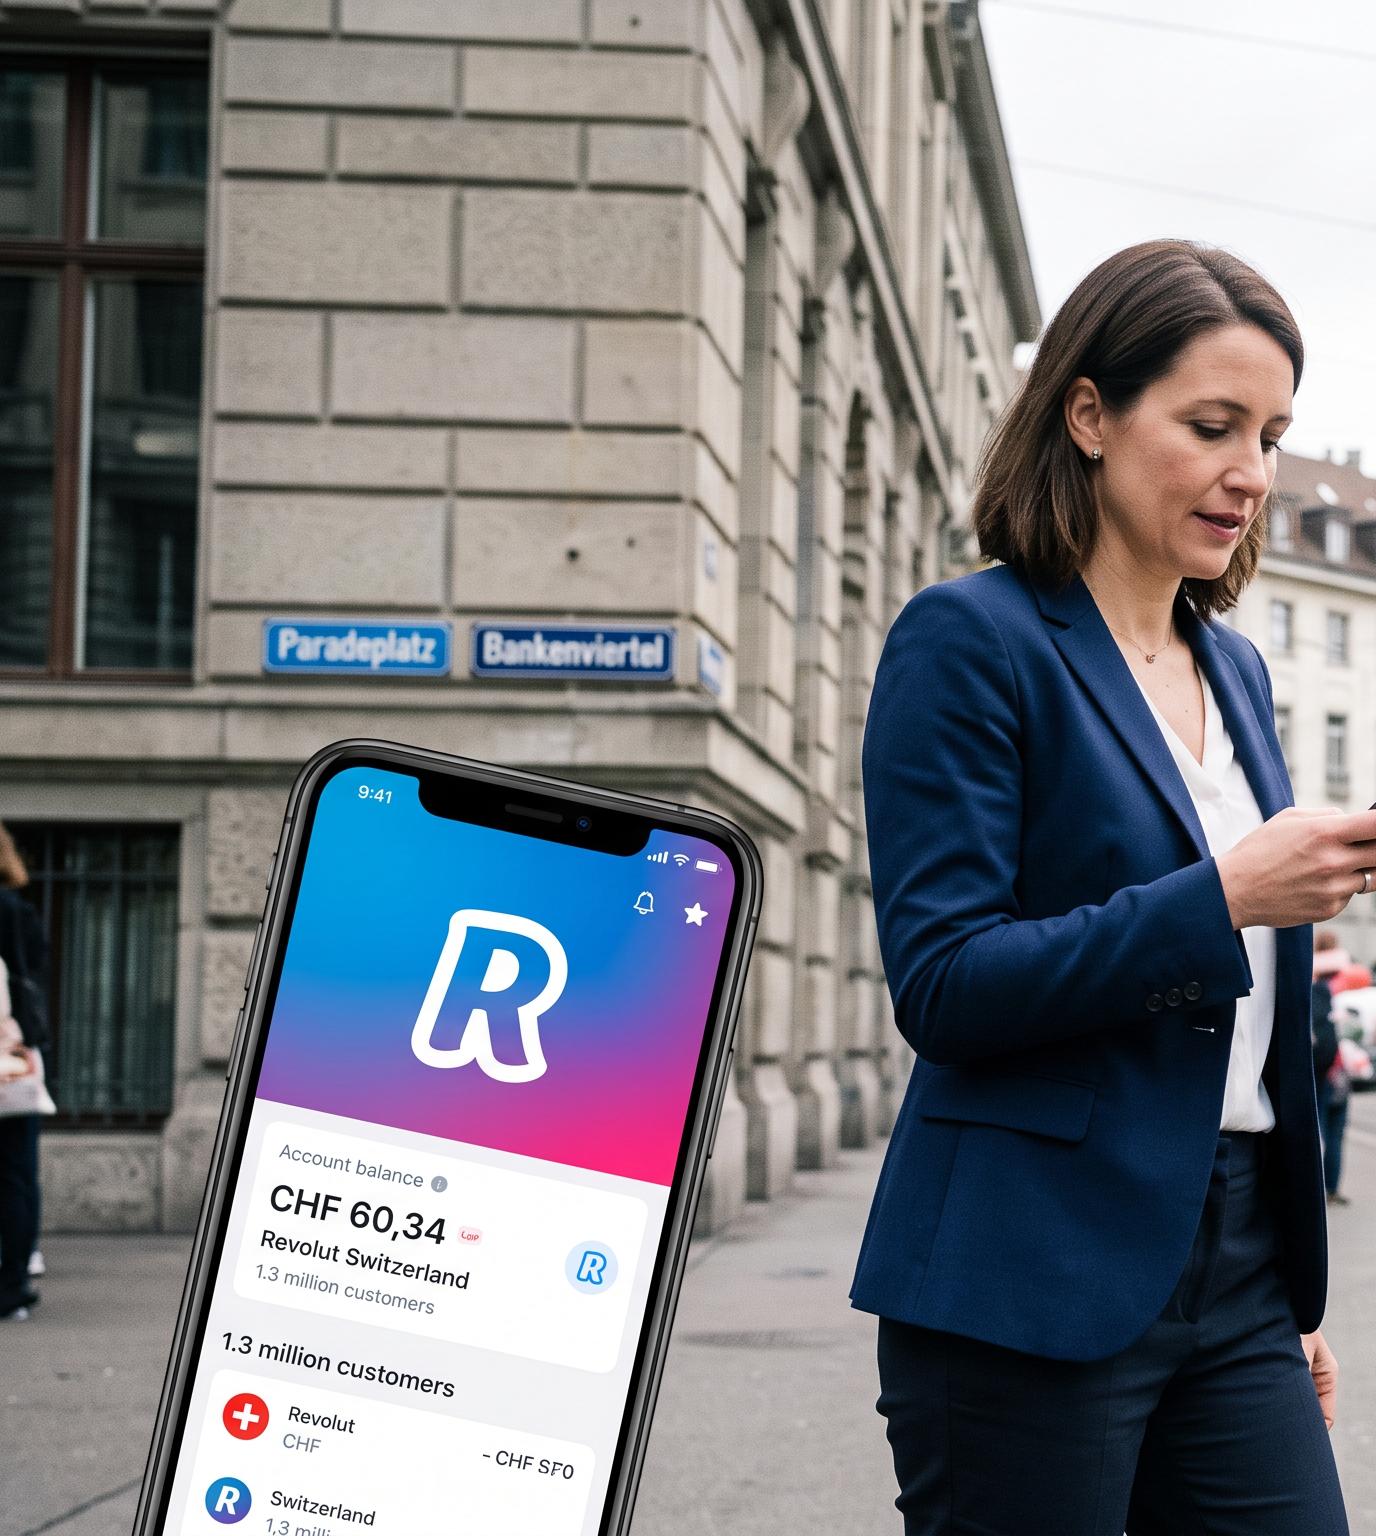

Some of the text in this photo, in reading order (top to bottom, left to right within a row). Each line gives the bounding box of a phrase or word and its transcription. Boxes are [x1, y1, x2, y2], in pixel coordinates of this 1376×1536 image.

[277, 626, 437, 670] Paradeplatz
[482, 630, 664, 668] Bankenviertel
[358, 785, 392, 804] 9:41
[411, 908, 569, 1083] R
[279, 1144, 424, 1187] Account balance
[270, 1184, 446, 1245] CHF 60,34
[260, 1229, 470, 1289] Revolut Switzerland
[256, 1264, 435, 1315] 1.3 million customers
[222, 1332, 455, 1398] 1.3 million customers
[288, 1406, 355, 1434] Revolut
[282, 1433, 321, 1453] CHF
[495, 1450, 535, 1470] CHF
[266, 1518, 290, 1536] 1,3
[270, 1490, 376, 1526] Switzerland
